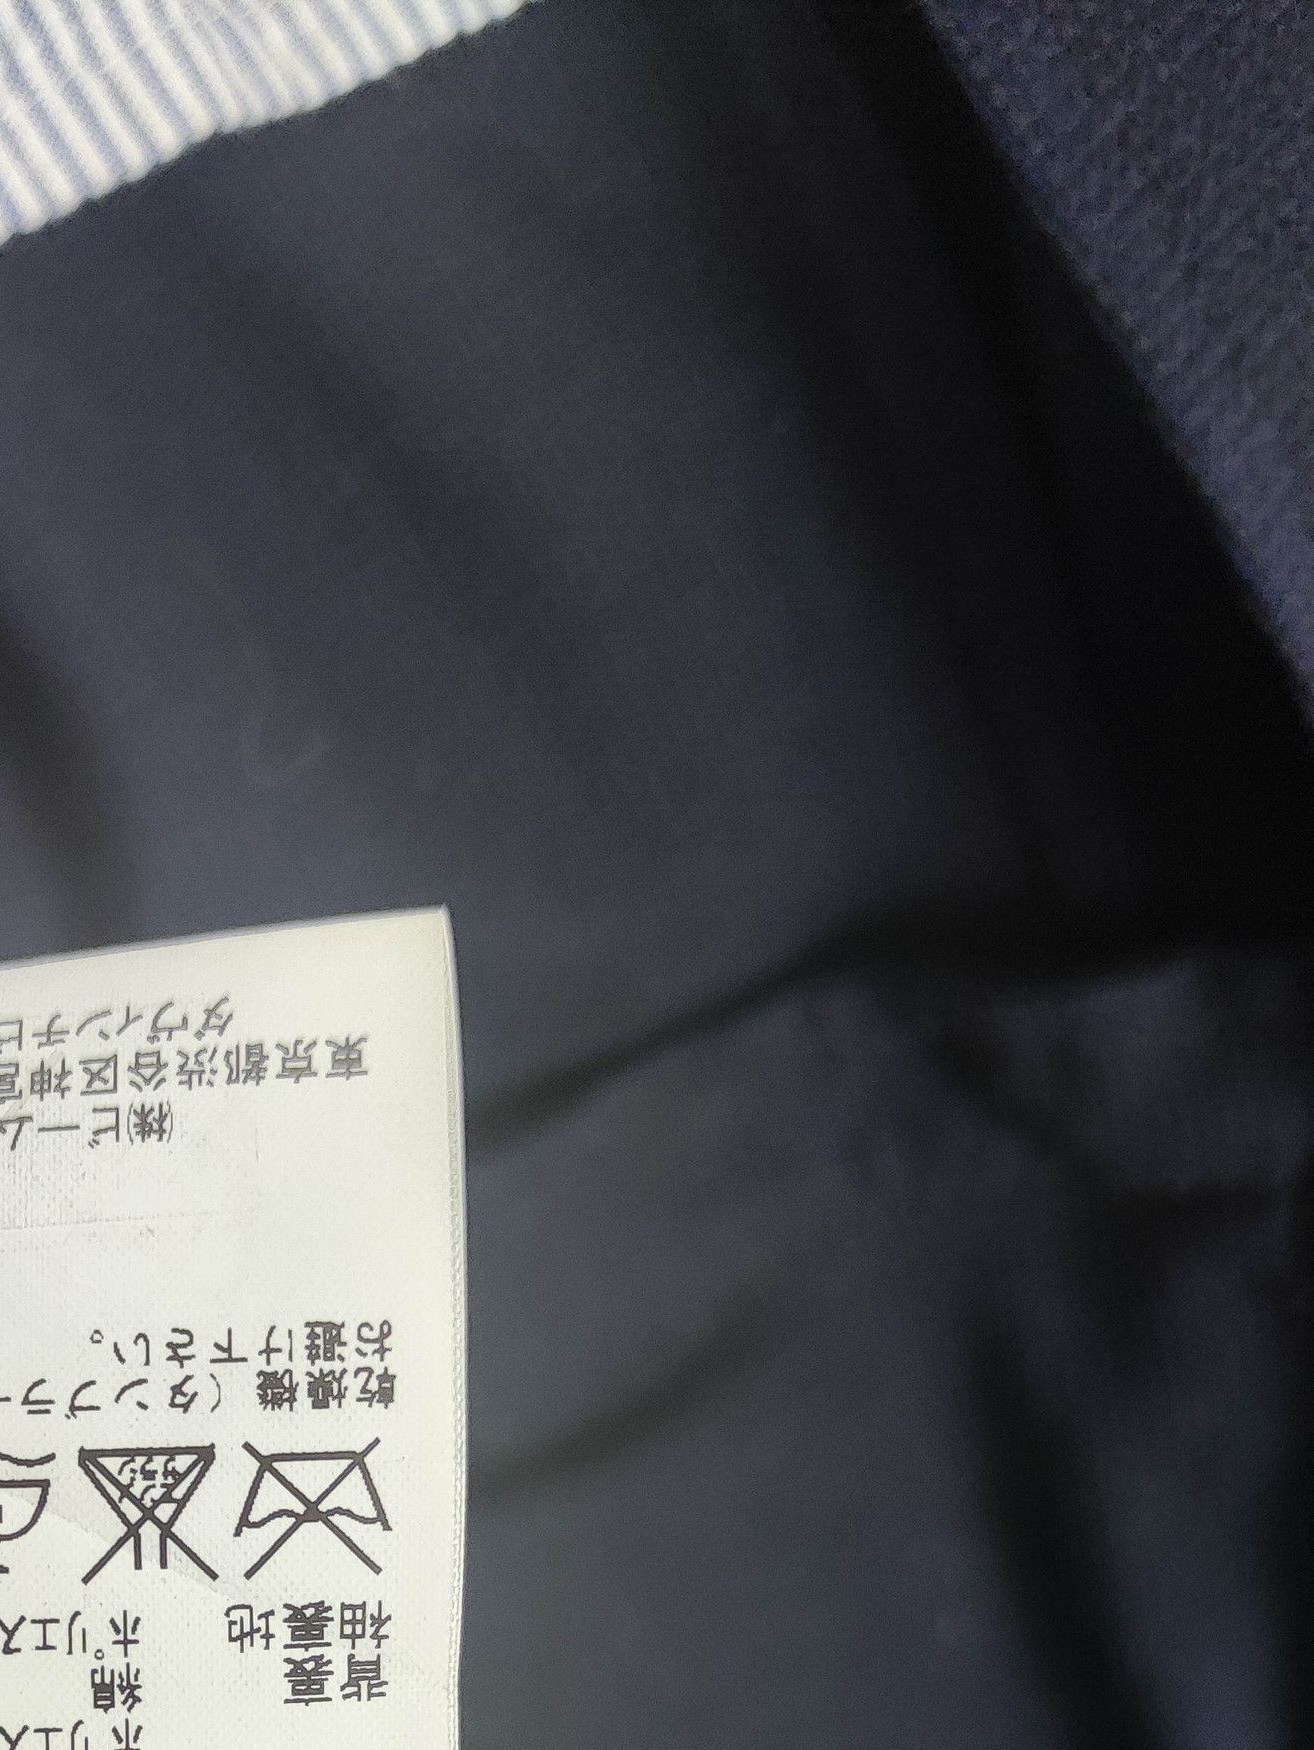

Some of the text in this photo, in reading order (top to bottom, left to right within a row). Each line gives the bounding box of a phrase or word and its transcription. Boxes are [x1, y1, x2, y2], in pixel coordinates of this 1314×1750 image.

[88, 1319, 396, 1367] お避け下さい。
[225, 1601, 393, 1653] 袖裏地
[91, 1663, 142, 1712] 綿
[284, 1652, 388, 1705] 背裏
